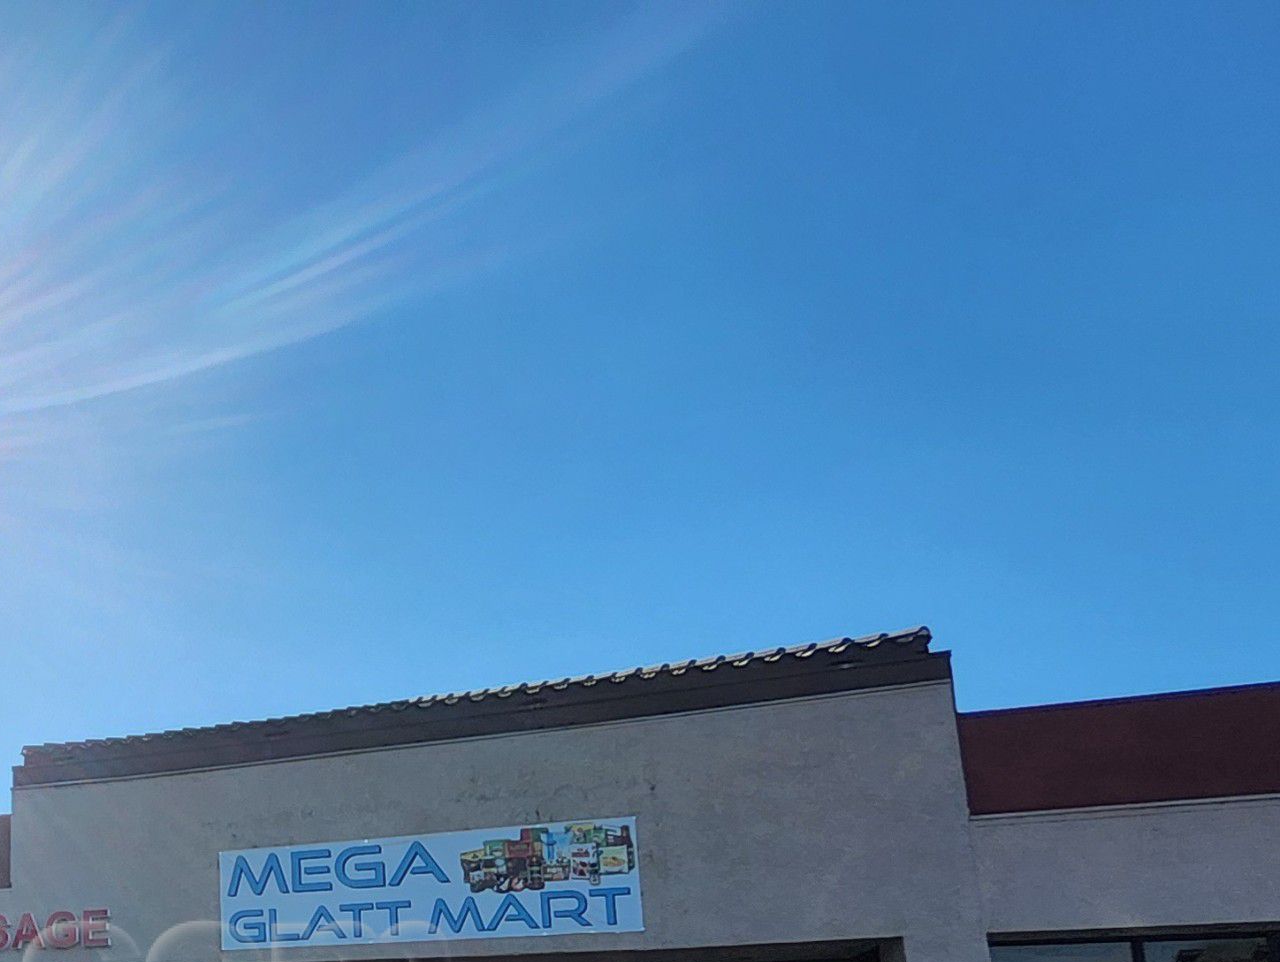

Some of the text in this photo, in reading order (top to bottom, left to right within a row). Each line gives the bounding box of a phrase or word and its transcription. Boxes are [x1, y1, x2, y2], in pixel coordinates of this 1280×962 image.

[227, 840, 451, 897] MEGA
[228, 887, 632, 944] GLATT MART
